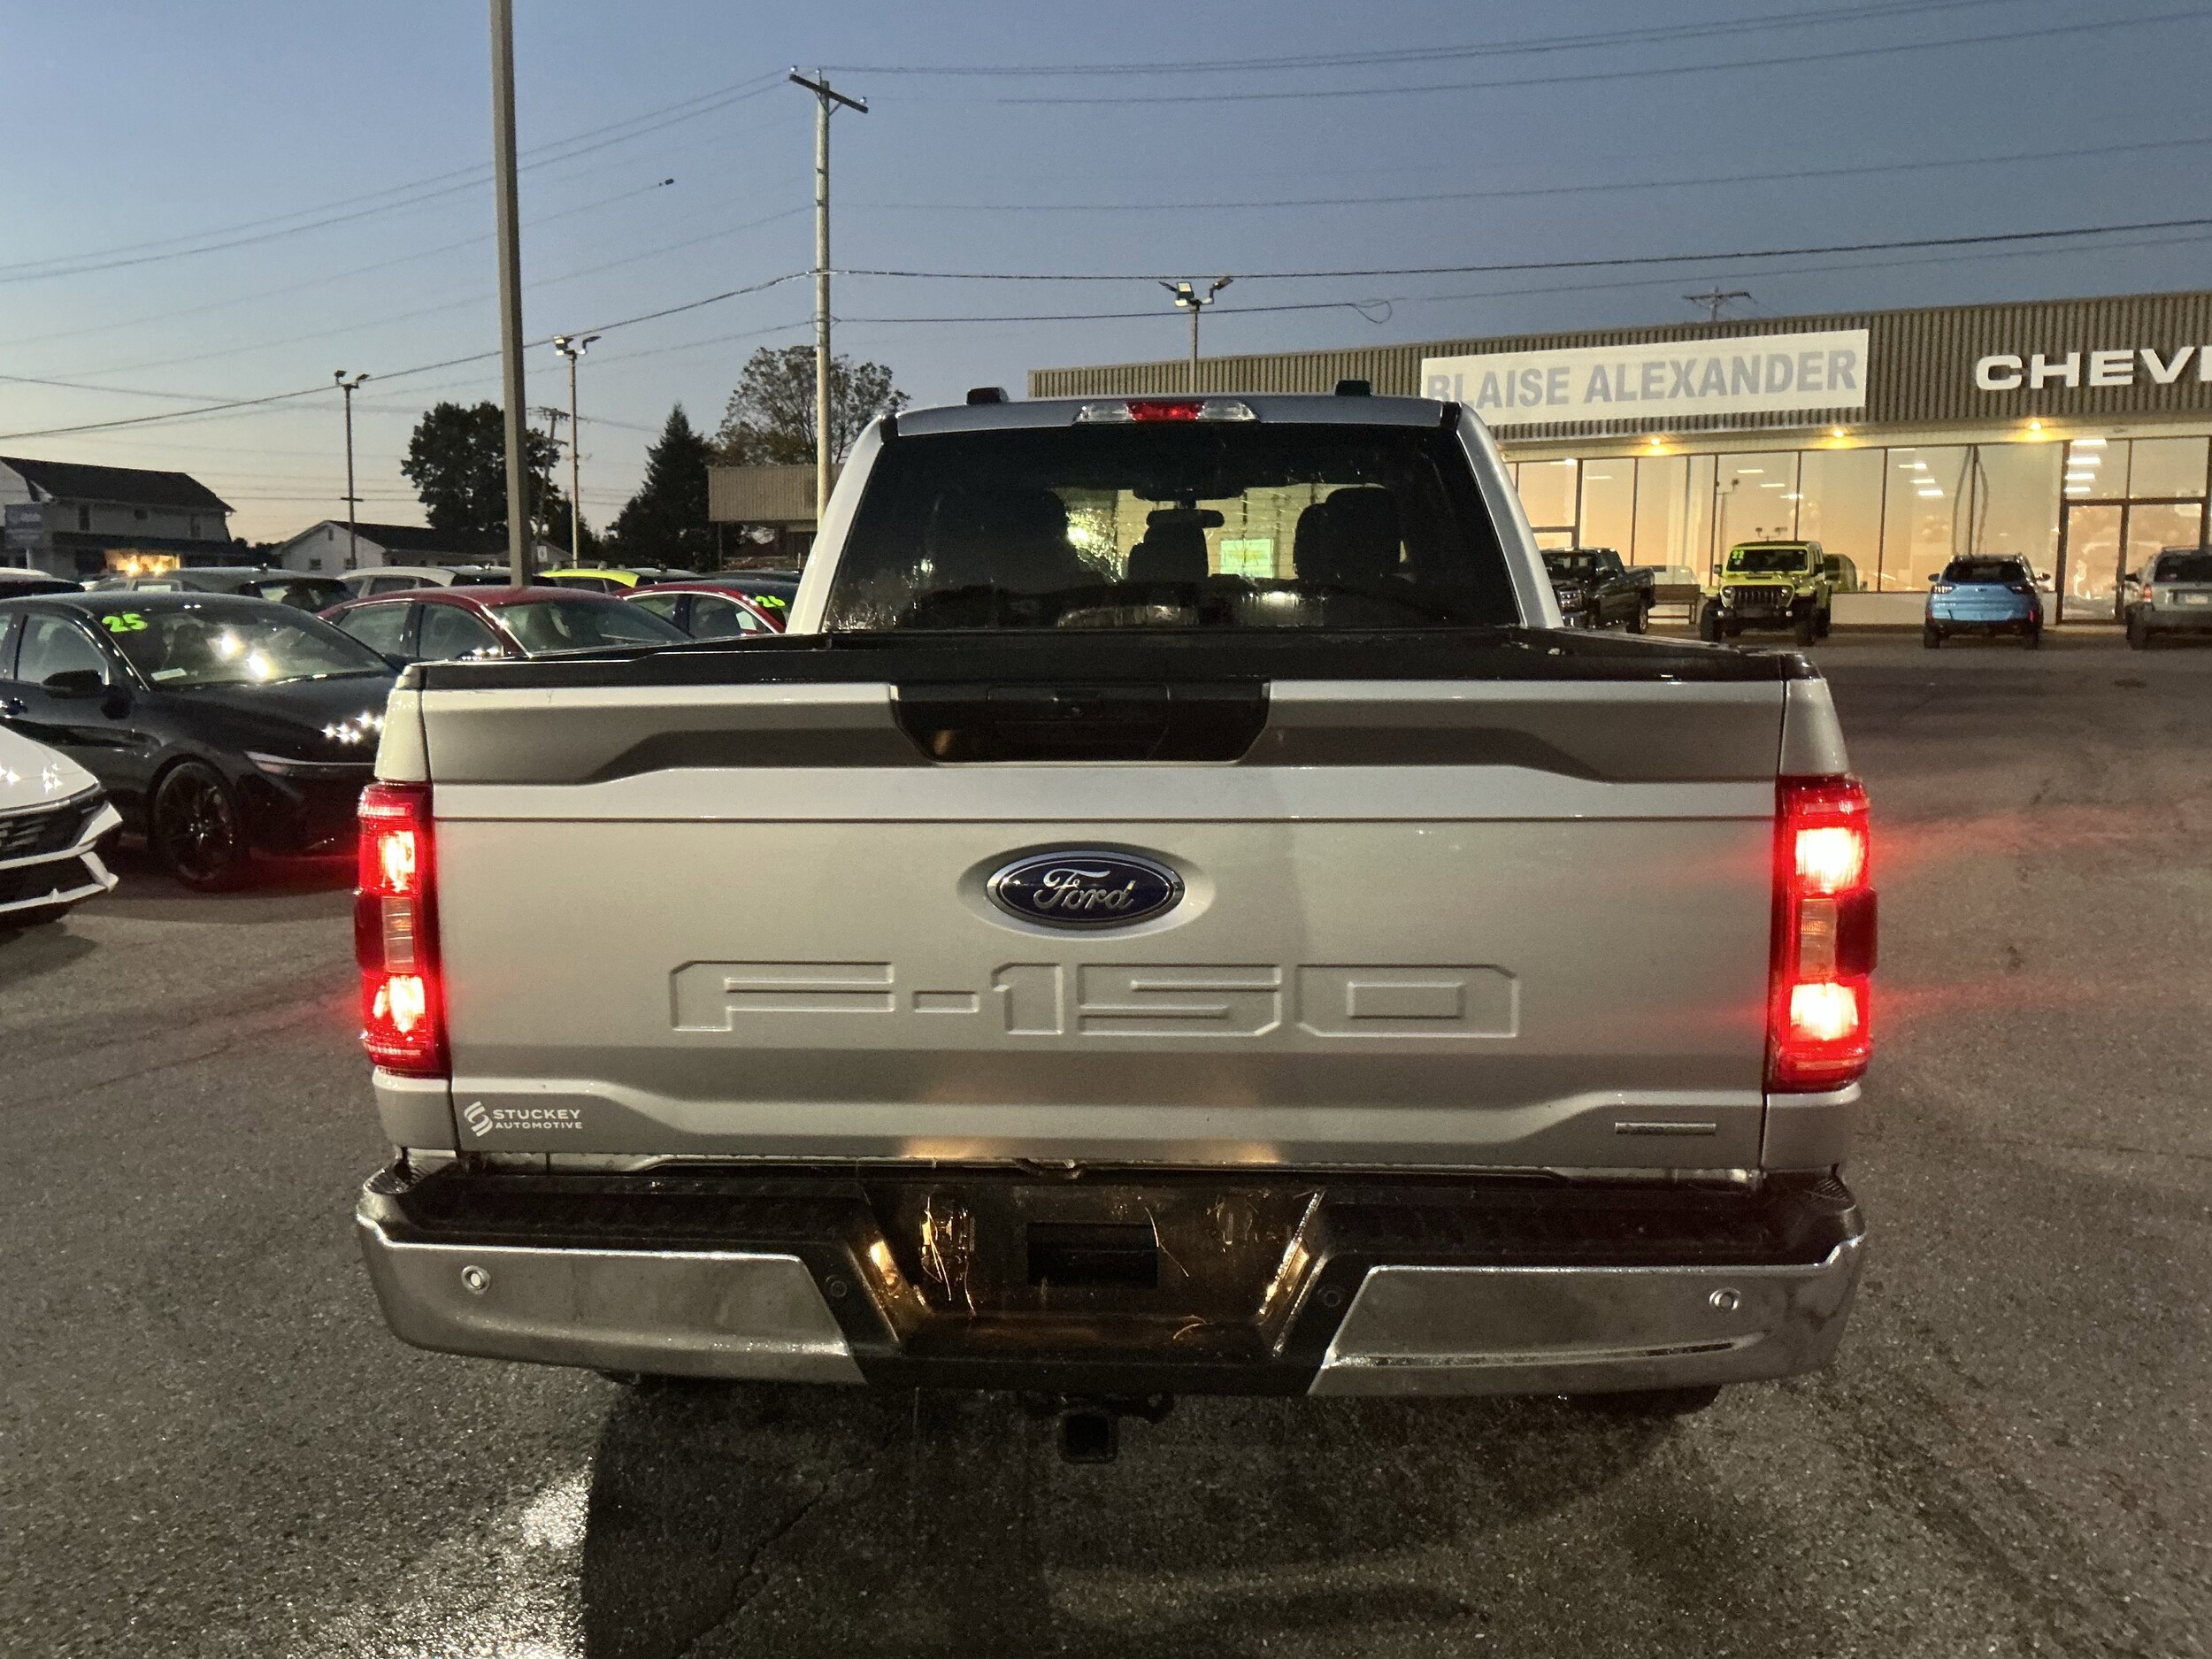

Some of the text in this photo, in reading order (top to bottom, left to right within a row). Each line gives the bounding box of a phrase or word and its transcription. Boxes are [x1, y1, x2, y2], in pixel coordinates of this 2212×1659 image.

[1427, 349, 1857, 409] BLAISE ALEXANDER
[1976, 346, 2212, 390] CHEV
[102, 613, 148, 632] 25
[755, 595, 786, 608] 26
[1033, 868, 1135, 910] Ford
[670, 960, 1520, 1040] F-150
[493, 1109, 581, 1120] STUCKEY
